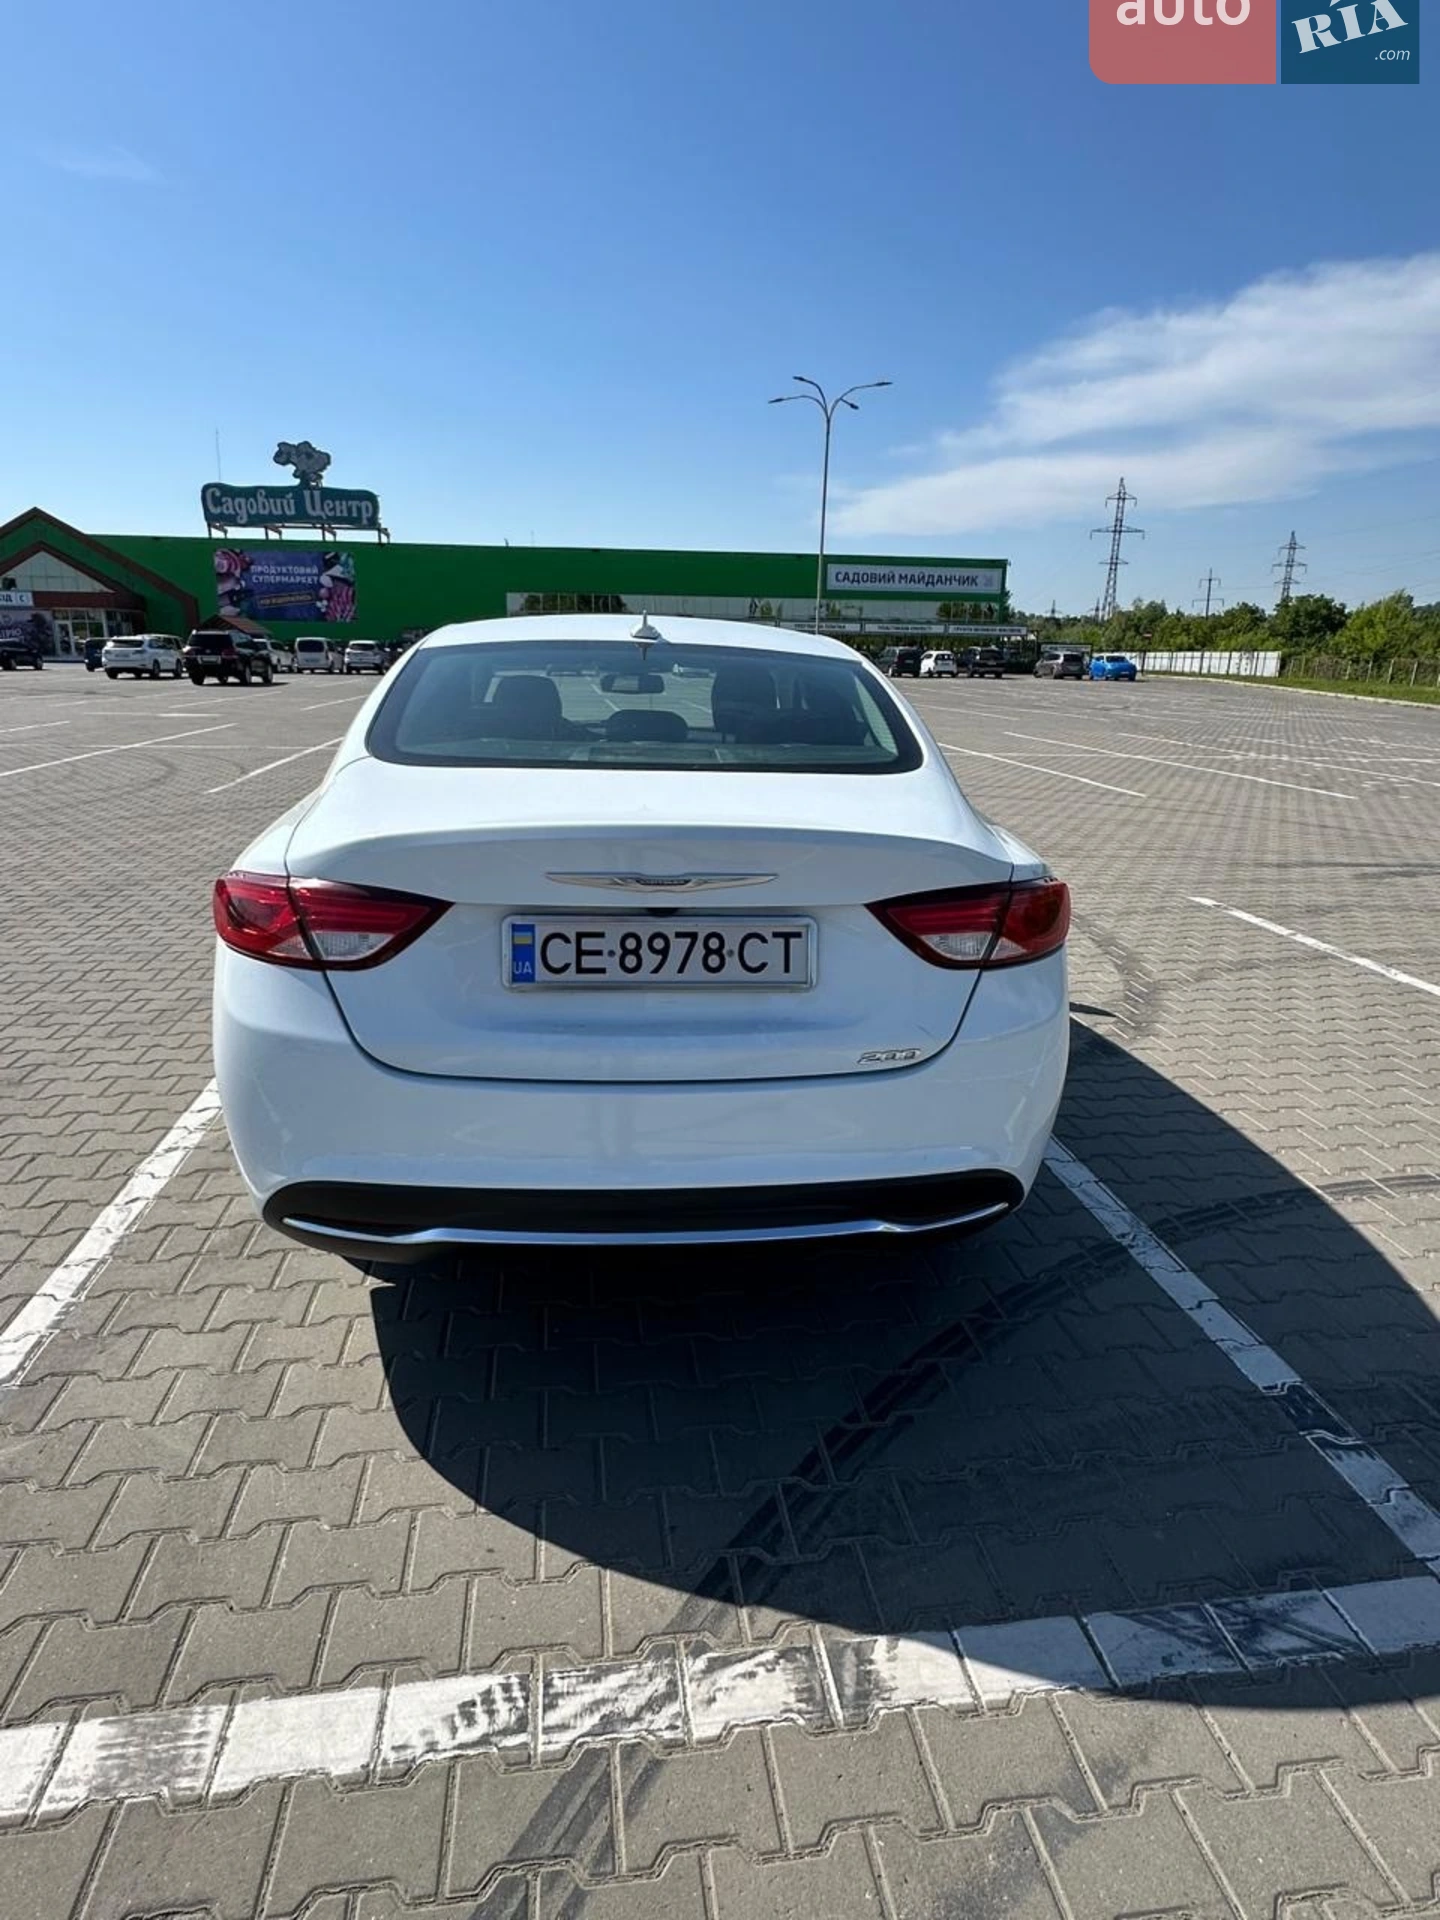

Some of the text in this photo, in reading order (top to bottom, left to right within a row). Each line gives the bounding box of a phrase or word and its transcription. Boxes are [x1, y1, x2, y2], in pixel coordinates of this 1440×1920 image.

[205, 487, 373, 524] Садовий Центр
[252, 575, 319, 585] СУПЕРМАРКЕТ
[835, 571, 978, 587] САДОВИЙ МАЙДАНЧИК
[540, 931, 803, 975] CE 8978 CT
[513, 960, 533, 975] UA
[857, 1048, 921, 1065] 200
